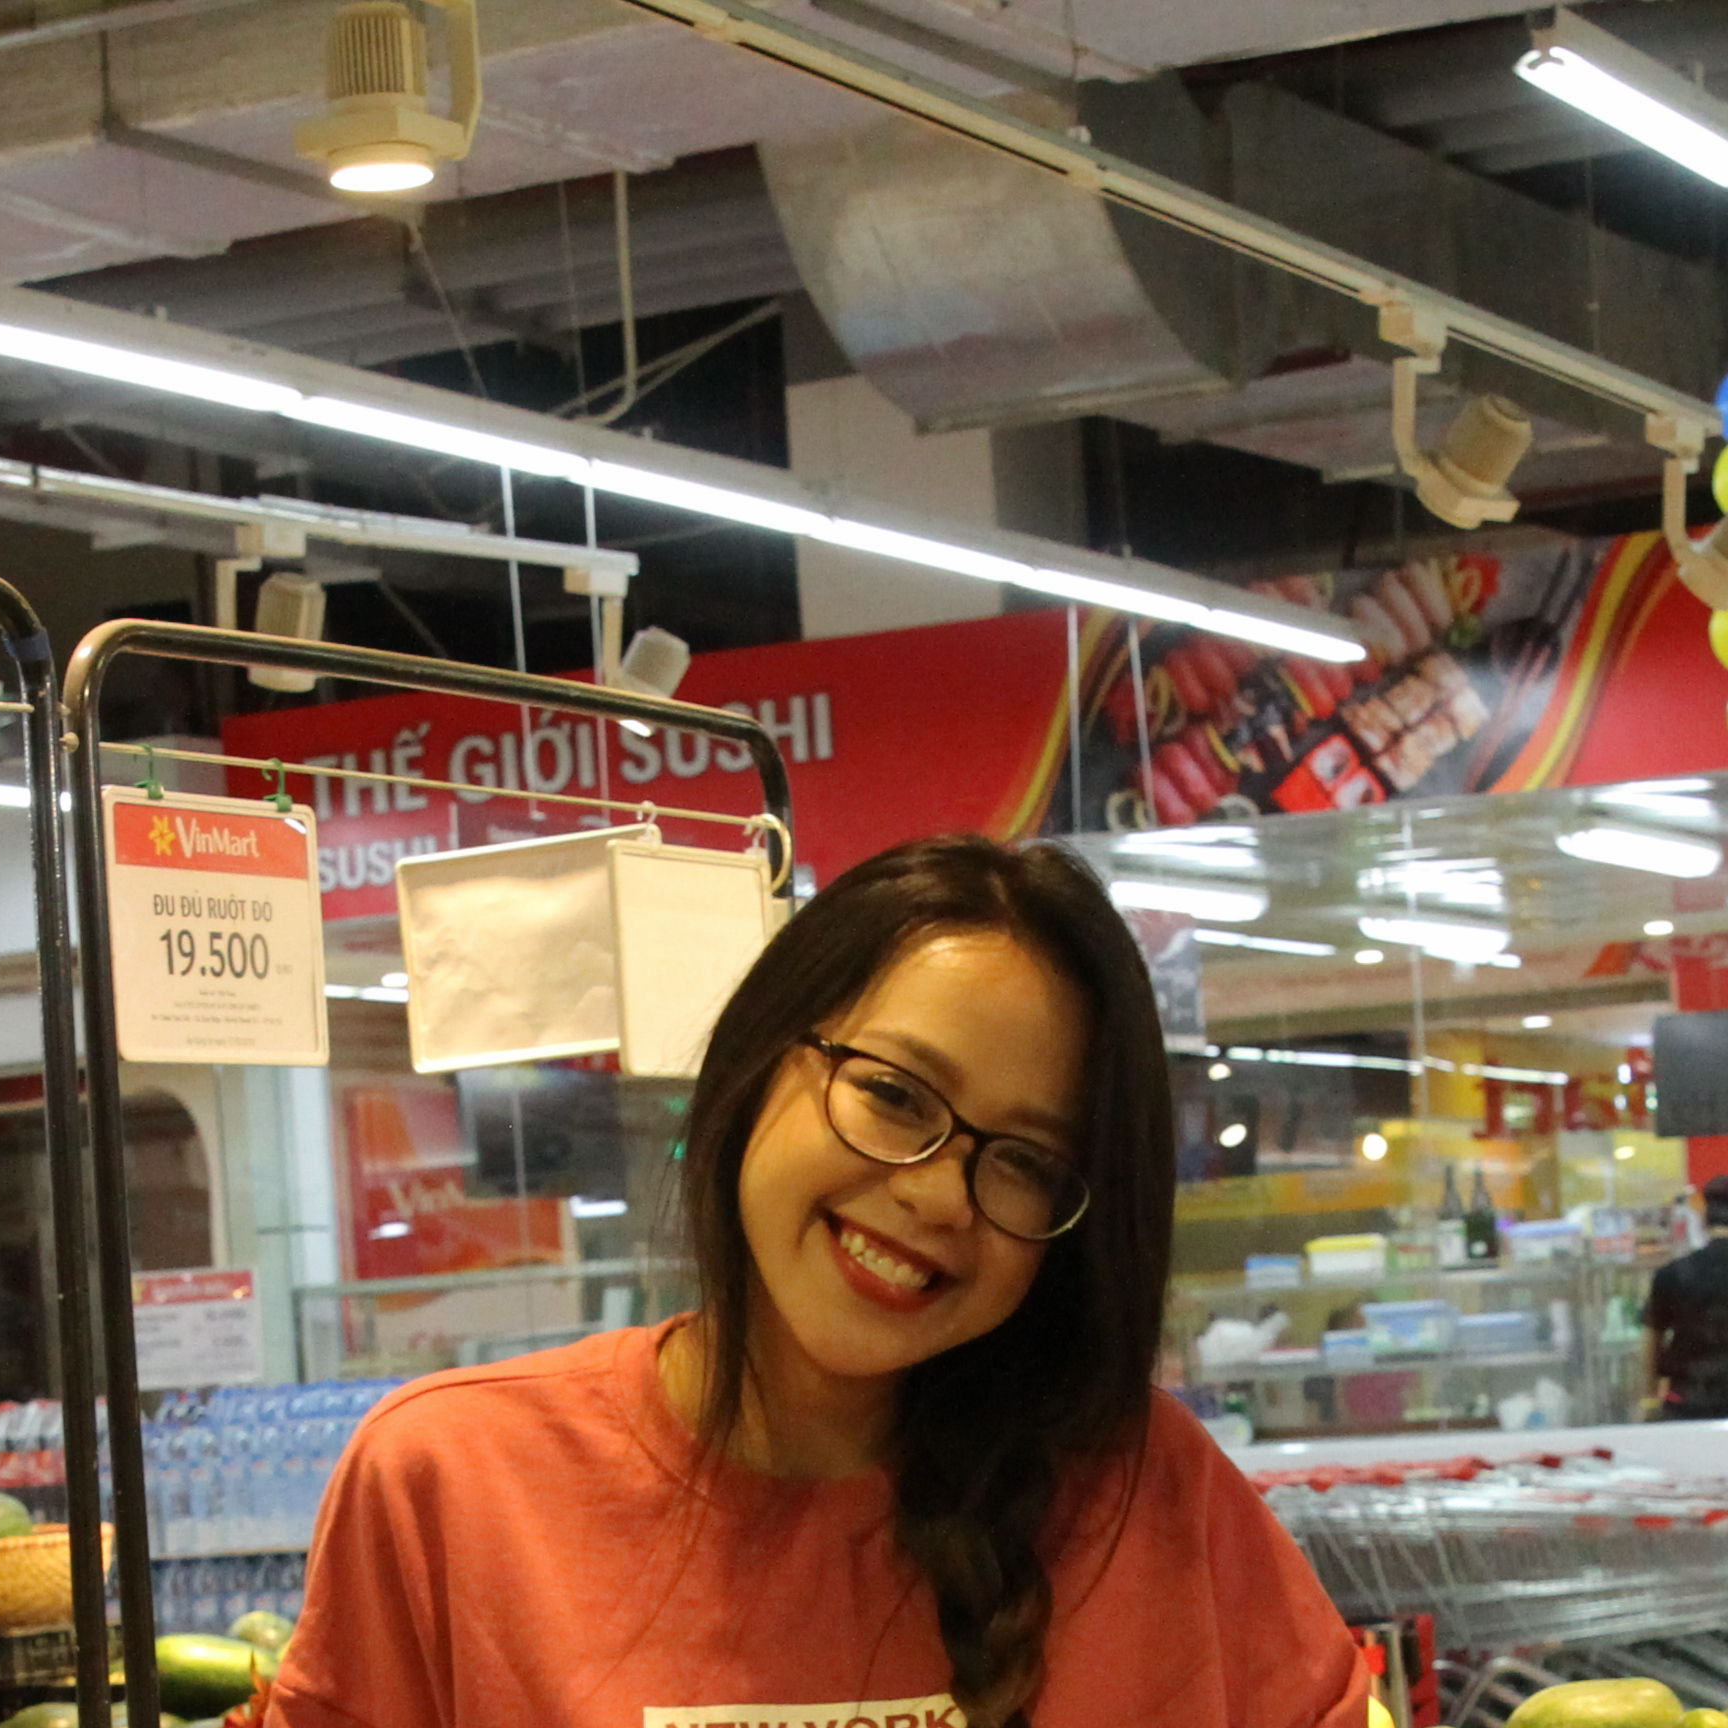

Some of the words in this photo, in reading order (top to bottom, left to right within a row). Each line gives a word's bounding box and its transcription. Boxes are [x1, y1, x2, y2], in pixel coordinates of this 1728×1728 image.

[304, 720, 431, 821] THẾ
[449, 709, 599, 802] GIỚI
[175, 815, 260, 859] VinMart
[153, 894, 175, 917] ĐU
[160, 928, 270, 980] 19.500
